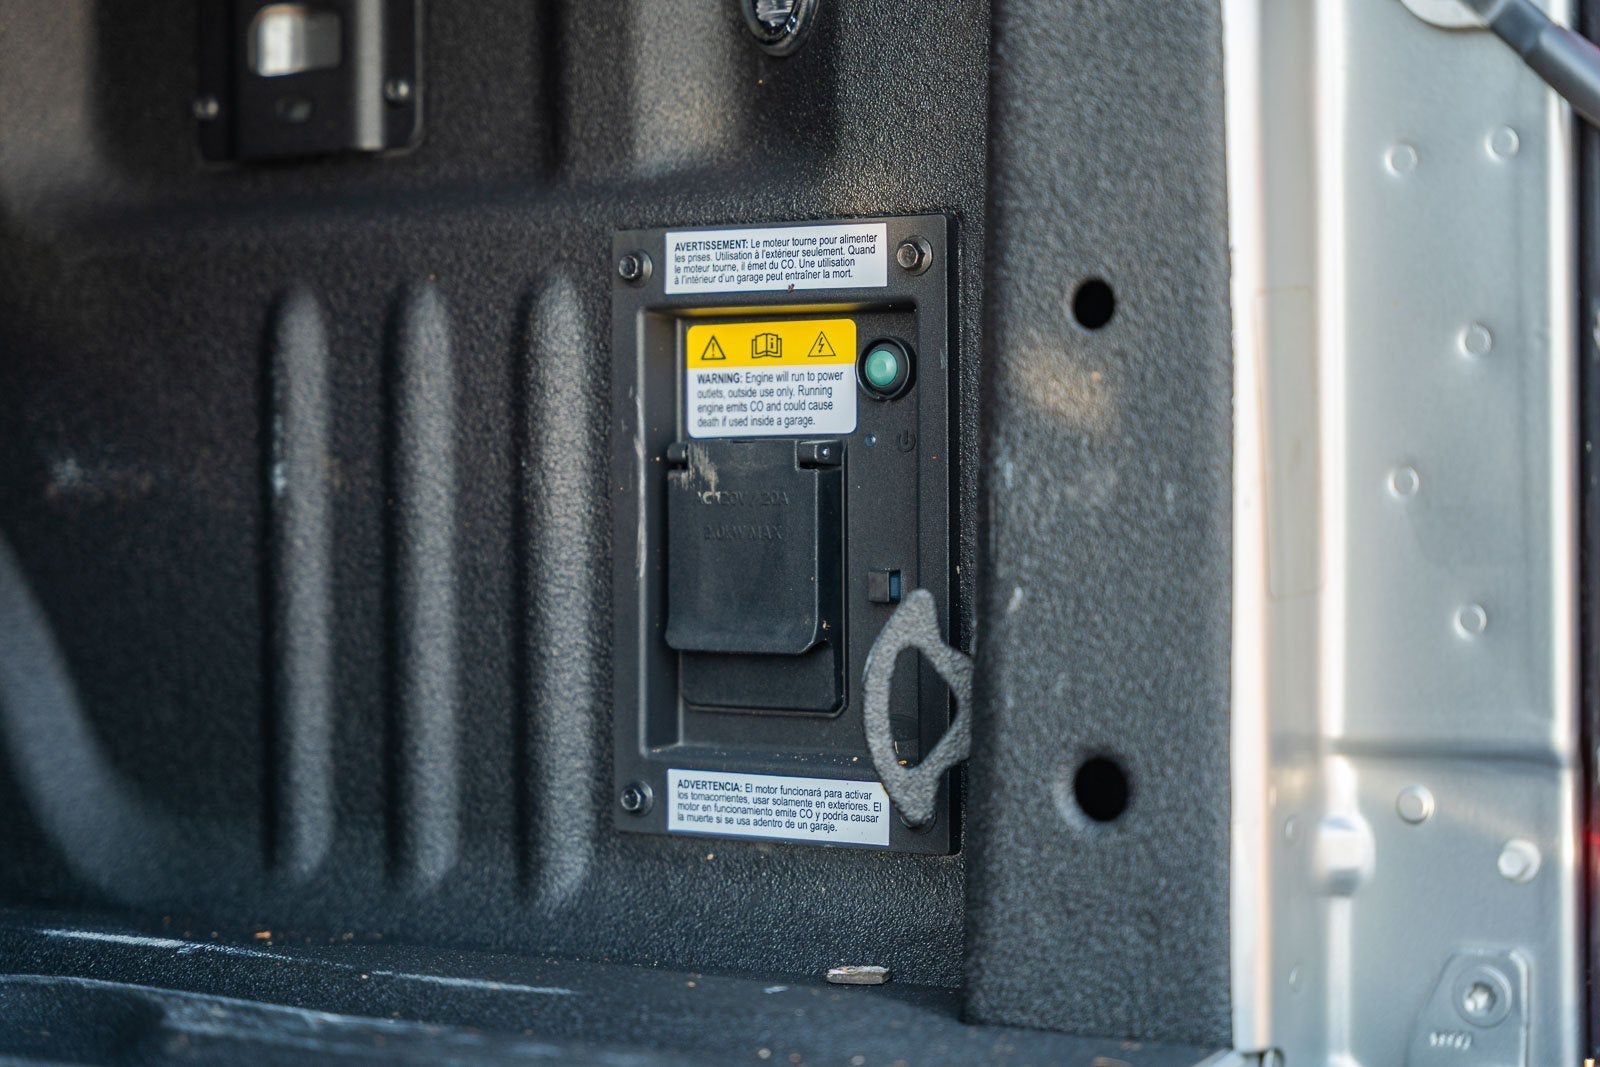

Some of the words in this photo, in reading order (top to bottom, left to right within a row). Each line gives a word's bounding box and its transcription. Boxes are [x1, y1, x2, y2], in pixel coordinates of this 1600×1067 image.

[674, 239, 748, 251] AVERTISSEMENT:
[751, 239, 760, 248] Le
[762, 238, 790, 248] moteur
[792, 236, 816, 246] tourne
[820, 236, 837, 247] pour
[840, 233, 877, 244] alimenter
[674, 253, 685, 262] les
[688, 252, 712, 264] prises.
[715, 250, 752, 261] Utilisation
[754, 249, 759, 258] à
[762, 247, 799, 258] l'extérieur
[802, 246, 845, 257] seulement.
[848, 245, 875, 255] Quand
[674, 264, 680, 274] le
[683, 264, 710, 273] moteur
[712, 262, 738, 274] tourne,
[741, 262, 745, 271] il
[748, 261, 767, 270] émet
[769, 260, 778, 269] du
[781, 259, 796, 269] CO.
[799, 259, 815, 268] Une
[817, 257, 855, 268] utilisation
[674, 276, 679, 285] à
[681, 274, 716, 284] l'intérieur
[719, 273, 734, 282] d'un
[737, 274, 763, 284] garage
[766, 272, 783, 283] peut
[785, 269, 820, 280] entraîner
[823, 269, 830, 278] la
[832, 269, 853, 278] mort.
[697, 374, 743, 383] WARNING:
[746, 372, 773, 385] Engine
[776, 371, 788, 382] will
[792, 373, 805, 381] run
[807, 372, 815, 381] to
[817, 371, 843, 385] power
[697, 388, 725, 400] outlets,
[728, 387, 756, 398] outside
[760, 388, 774, 397] use
[776, 387, 795, 399] only.
[798, 385, 832, 398] Running
[697, 402, 724, 415] engine
[726, 402, 747, 412] emits
[750, 401, 764, 411] CO
[766, 400, 781, 411] and
[784, 400, 806, 411] could
[808, 401, 833, 410] cause
[697, 416, 719, 427] death
[722, 416, 726, 426] if
[729, 416, 748, 426] used
[750, 415, 774, 426] inside
[784, 417, 815, 428] garage.
[678, 780, 742, 792] ADVERTENCIA:
[745, 783, 753, 793] El
[755, 786, 777, 794] motor
[780, 785, 821, 797] funcionará
[824, 789, 842, 800] para
[844, 790, 872, 800] activar
[678, 791, 689, 800] los
[691, 792, 750, 804] tomacorrientes,
[772, 797, 813, 807] solamente
[815, 800, 825, 808] en
[828, 800, 870, 811] exteriores.
[873, 802, 881, 811] El
[678, 803, 699, 811] motor
[714, 803, 773, 816] funcionamiento
[775, 808, 797, 818] emite
[800, 809, 813, 819] CO
[815, 811, 820, 821] y
[823, 810, 848, 822] podría
[851, 813, 879, 823] causar
[678, 813, 684, 821] la
[687, 814, 713, 823] muerte
[715, 816, 723, 824] si
[753, 817, 782, 827] adentro
[785, 820, 795, 828] de
[810, 820, 837, 833] garaje.
